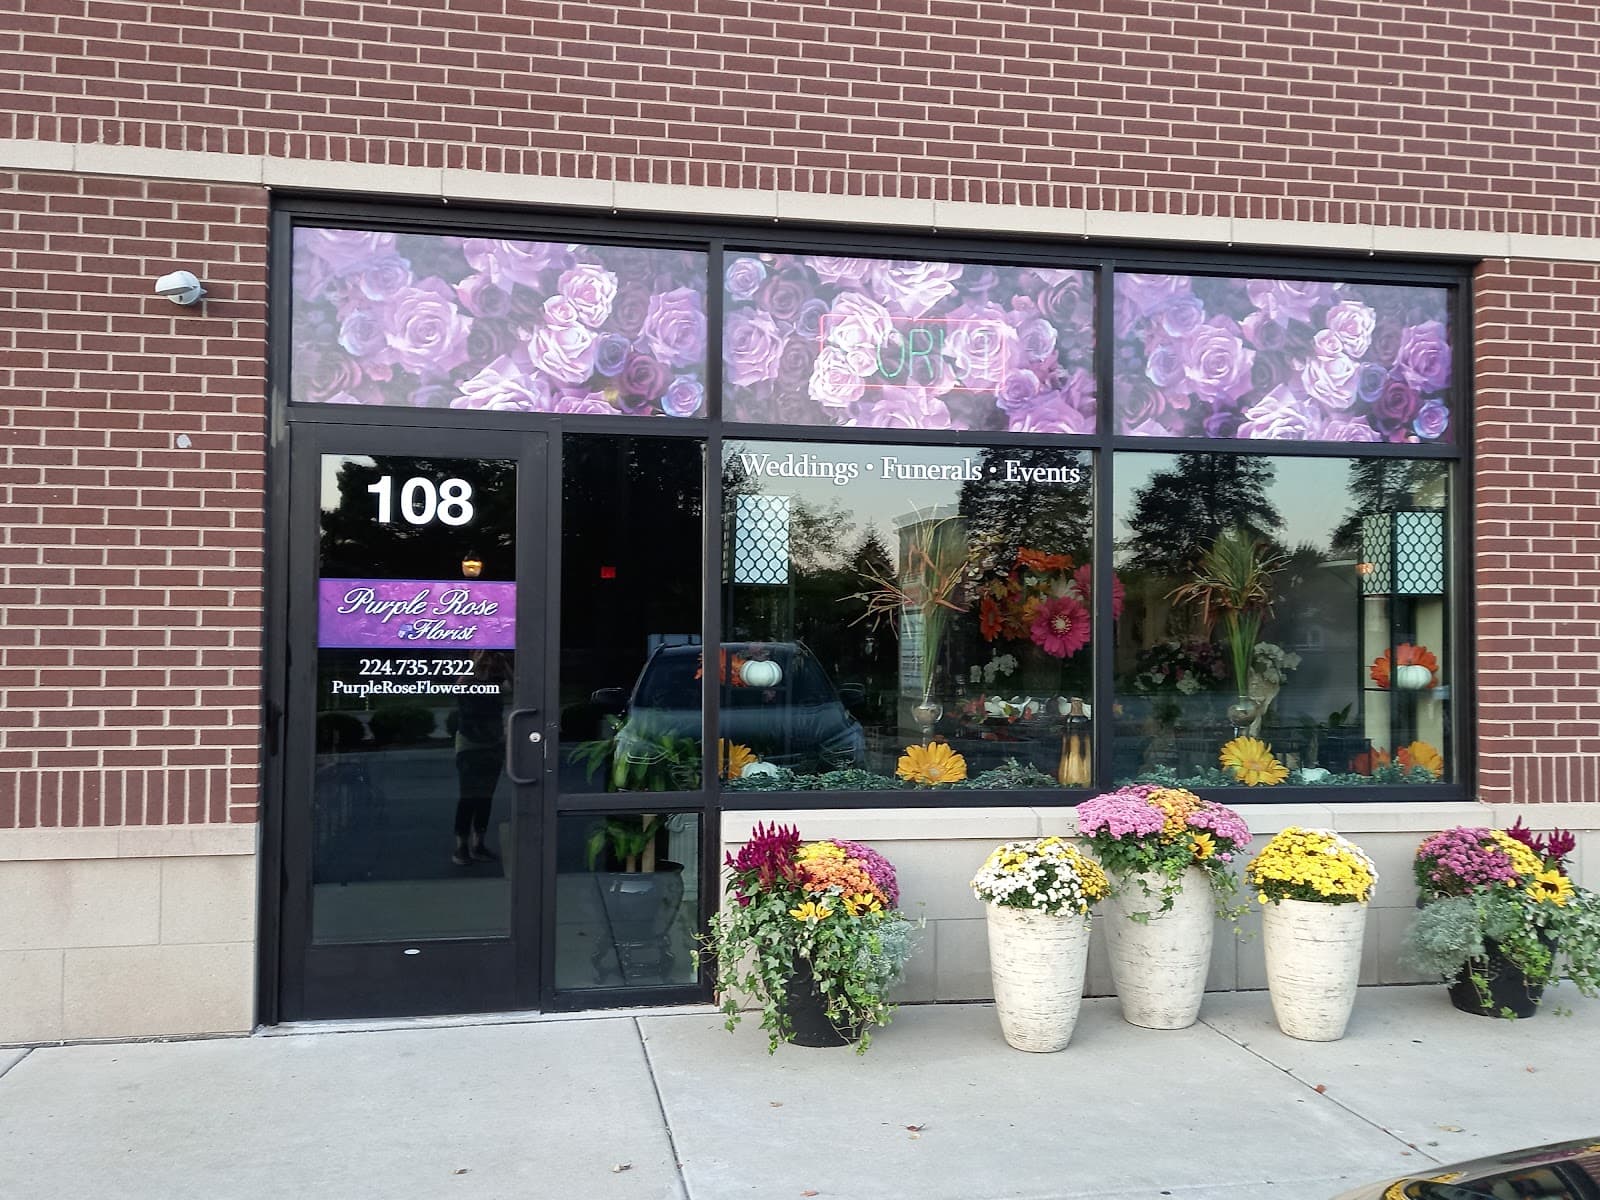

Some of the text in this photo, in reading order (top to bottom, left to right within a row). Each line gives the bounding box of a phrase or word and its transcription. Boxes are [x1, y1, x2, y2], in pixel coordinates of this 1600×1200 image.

[739, 453, 1081, 485] Weddings Funerals Events
[367, 475, 475, 526] 108
[337, 587, 499, 623] Purple Rose
[407, 618, 478, 641] Florist
[359, 658, 475, 677] 224.735.7322
[332, 680, 501, 698] PurpleRoseFlower.com
